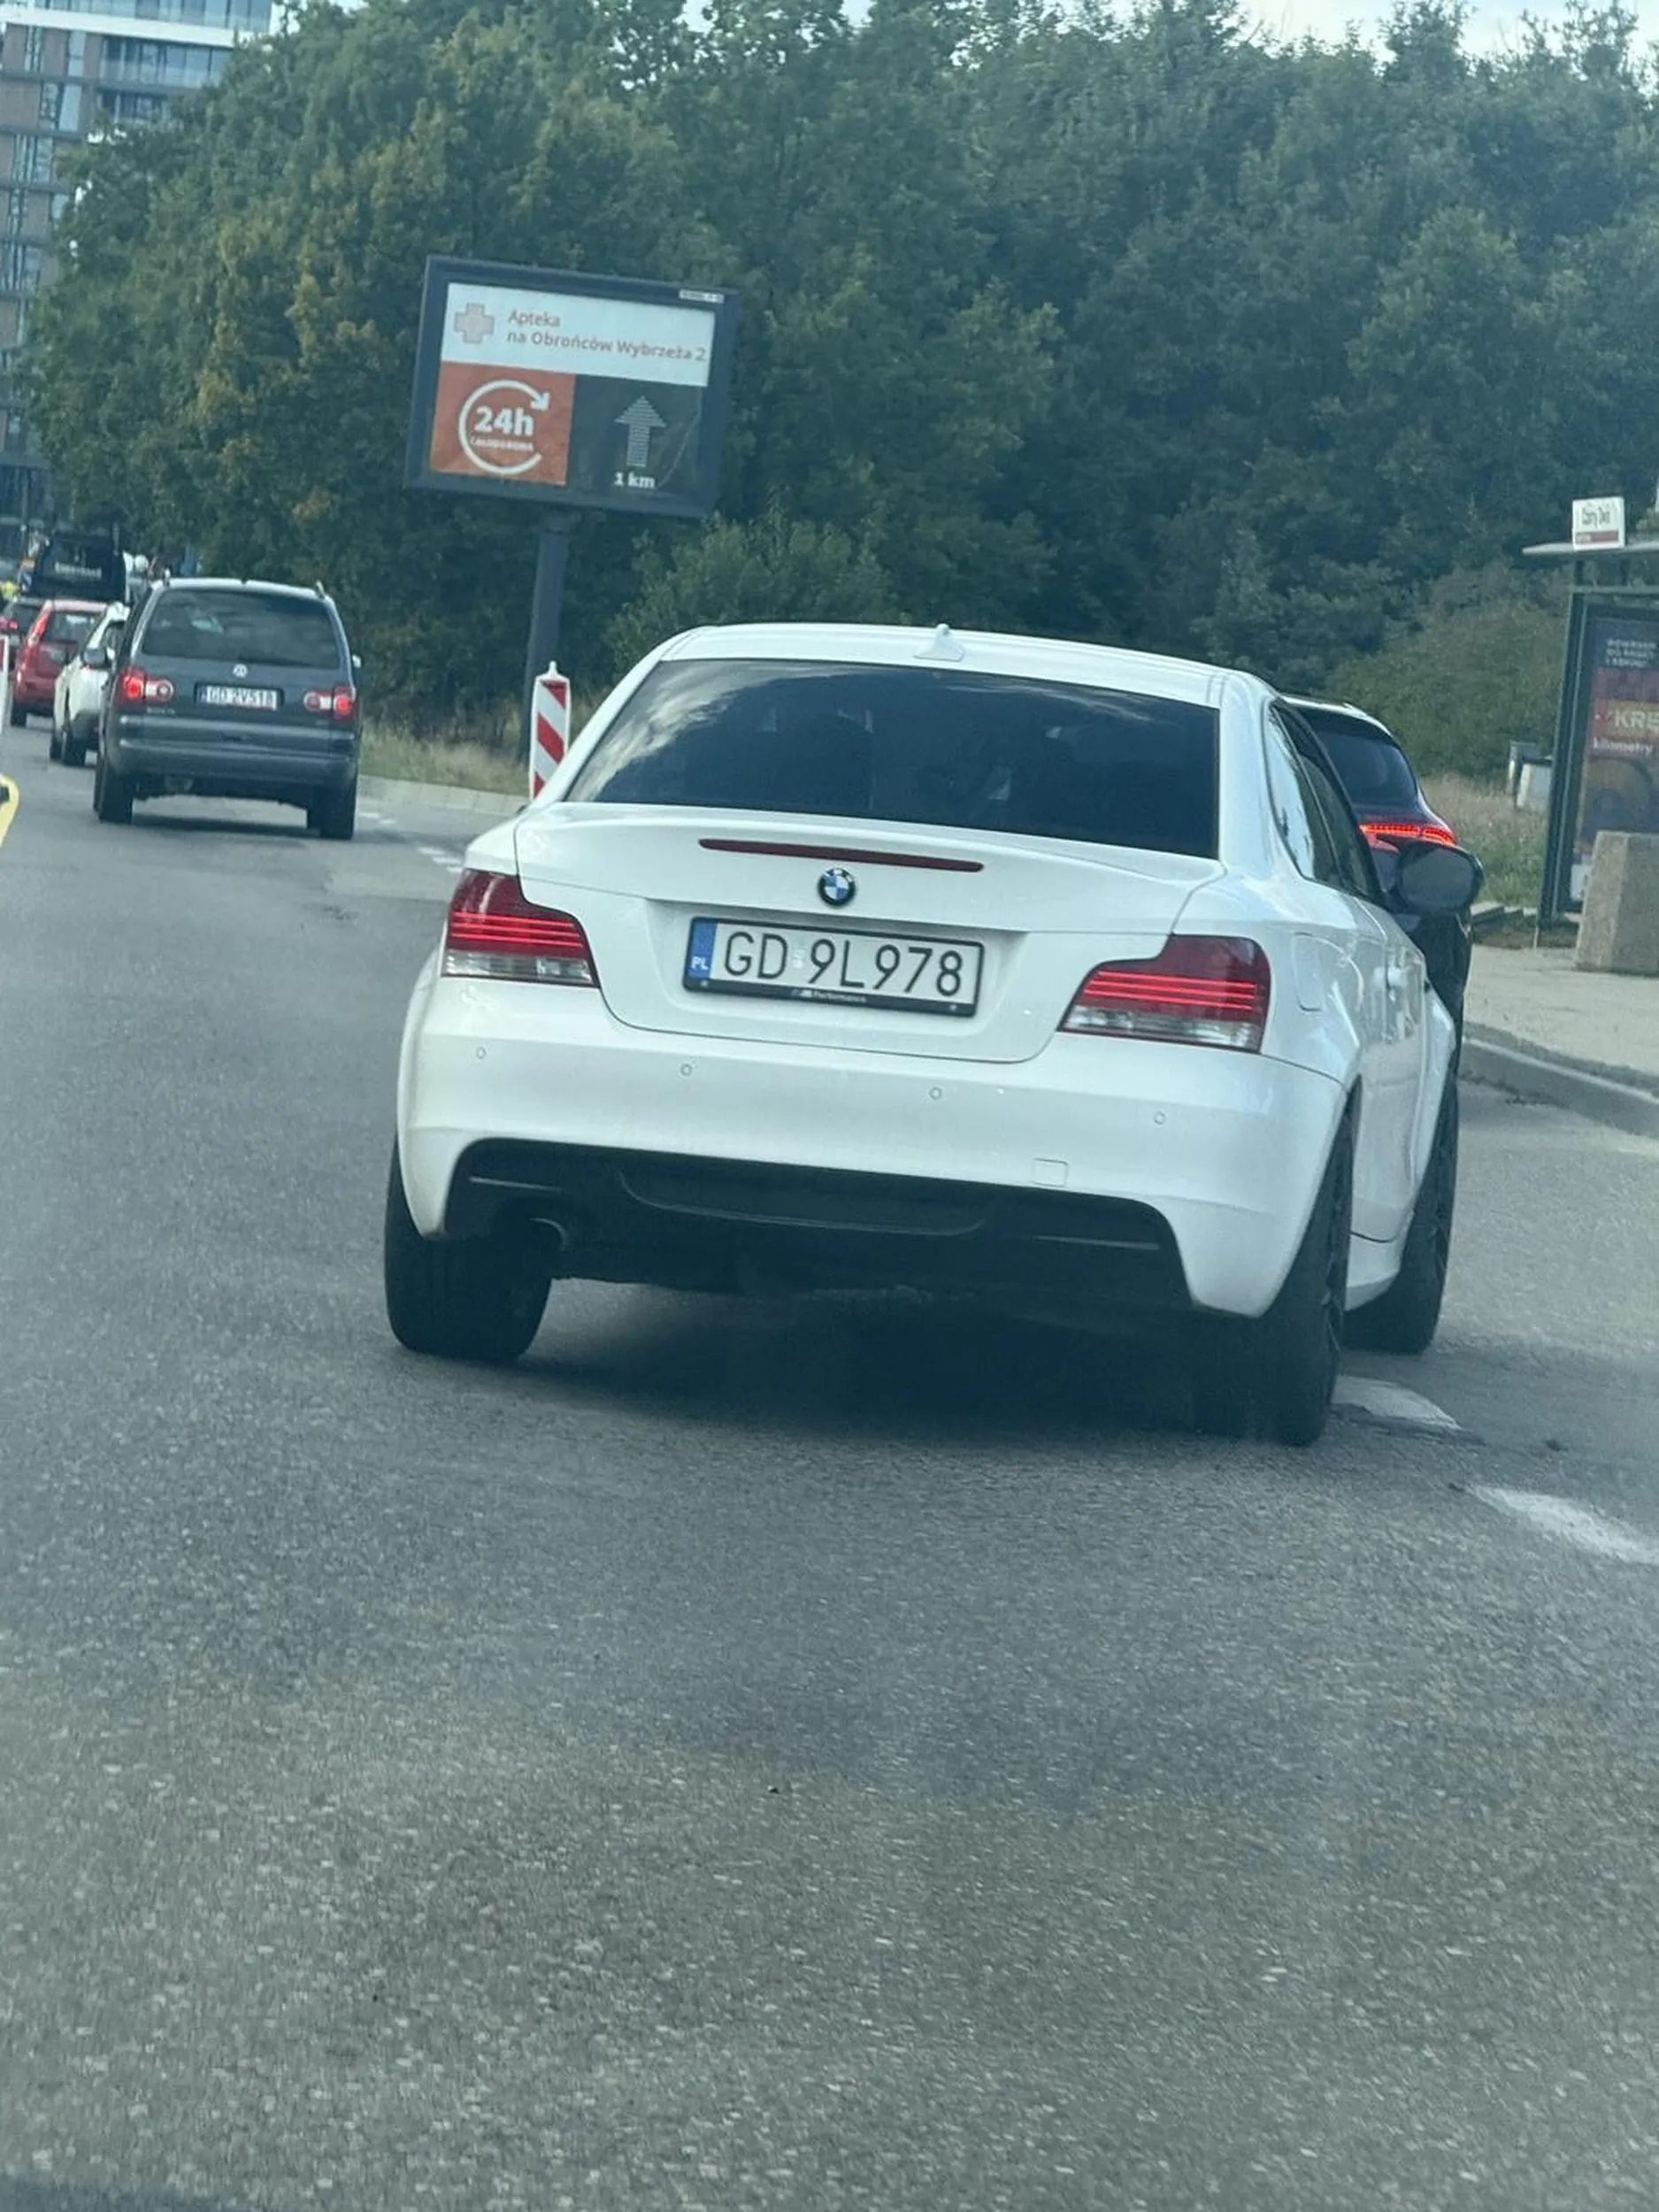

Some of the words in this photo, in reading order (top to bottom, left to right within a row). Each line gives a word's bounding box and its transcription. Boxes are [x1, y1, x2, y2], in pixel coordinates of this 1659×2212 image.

[508, 310, 561, 328] Apteka
[507, 331, 526, 343] na
[531, 330, 613, 352] Obrońców
[695, 347, 707, 362] 2
[473, 405, 534, 435] 24h
[614, 472, 624, 486] 1
[628, 471, 656, 488] km
[691, 956, 709, 970] PL
[724, 931, 788, 979] GD
[809, 939, 963, 996] 9L978
